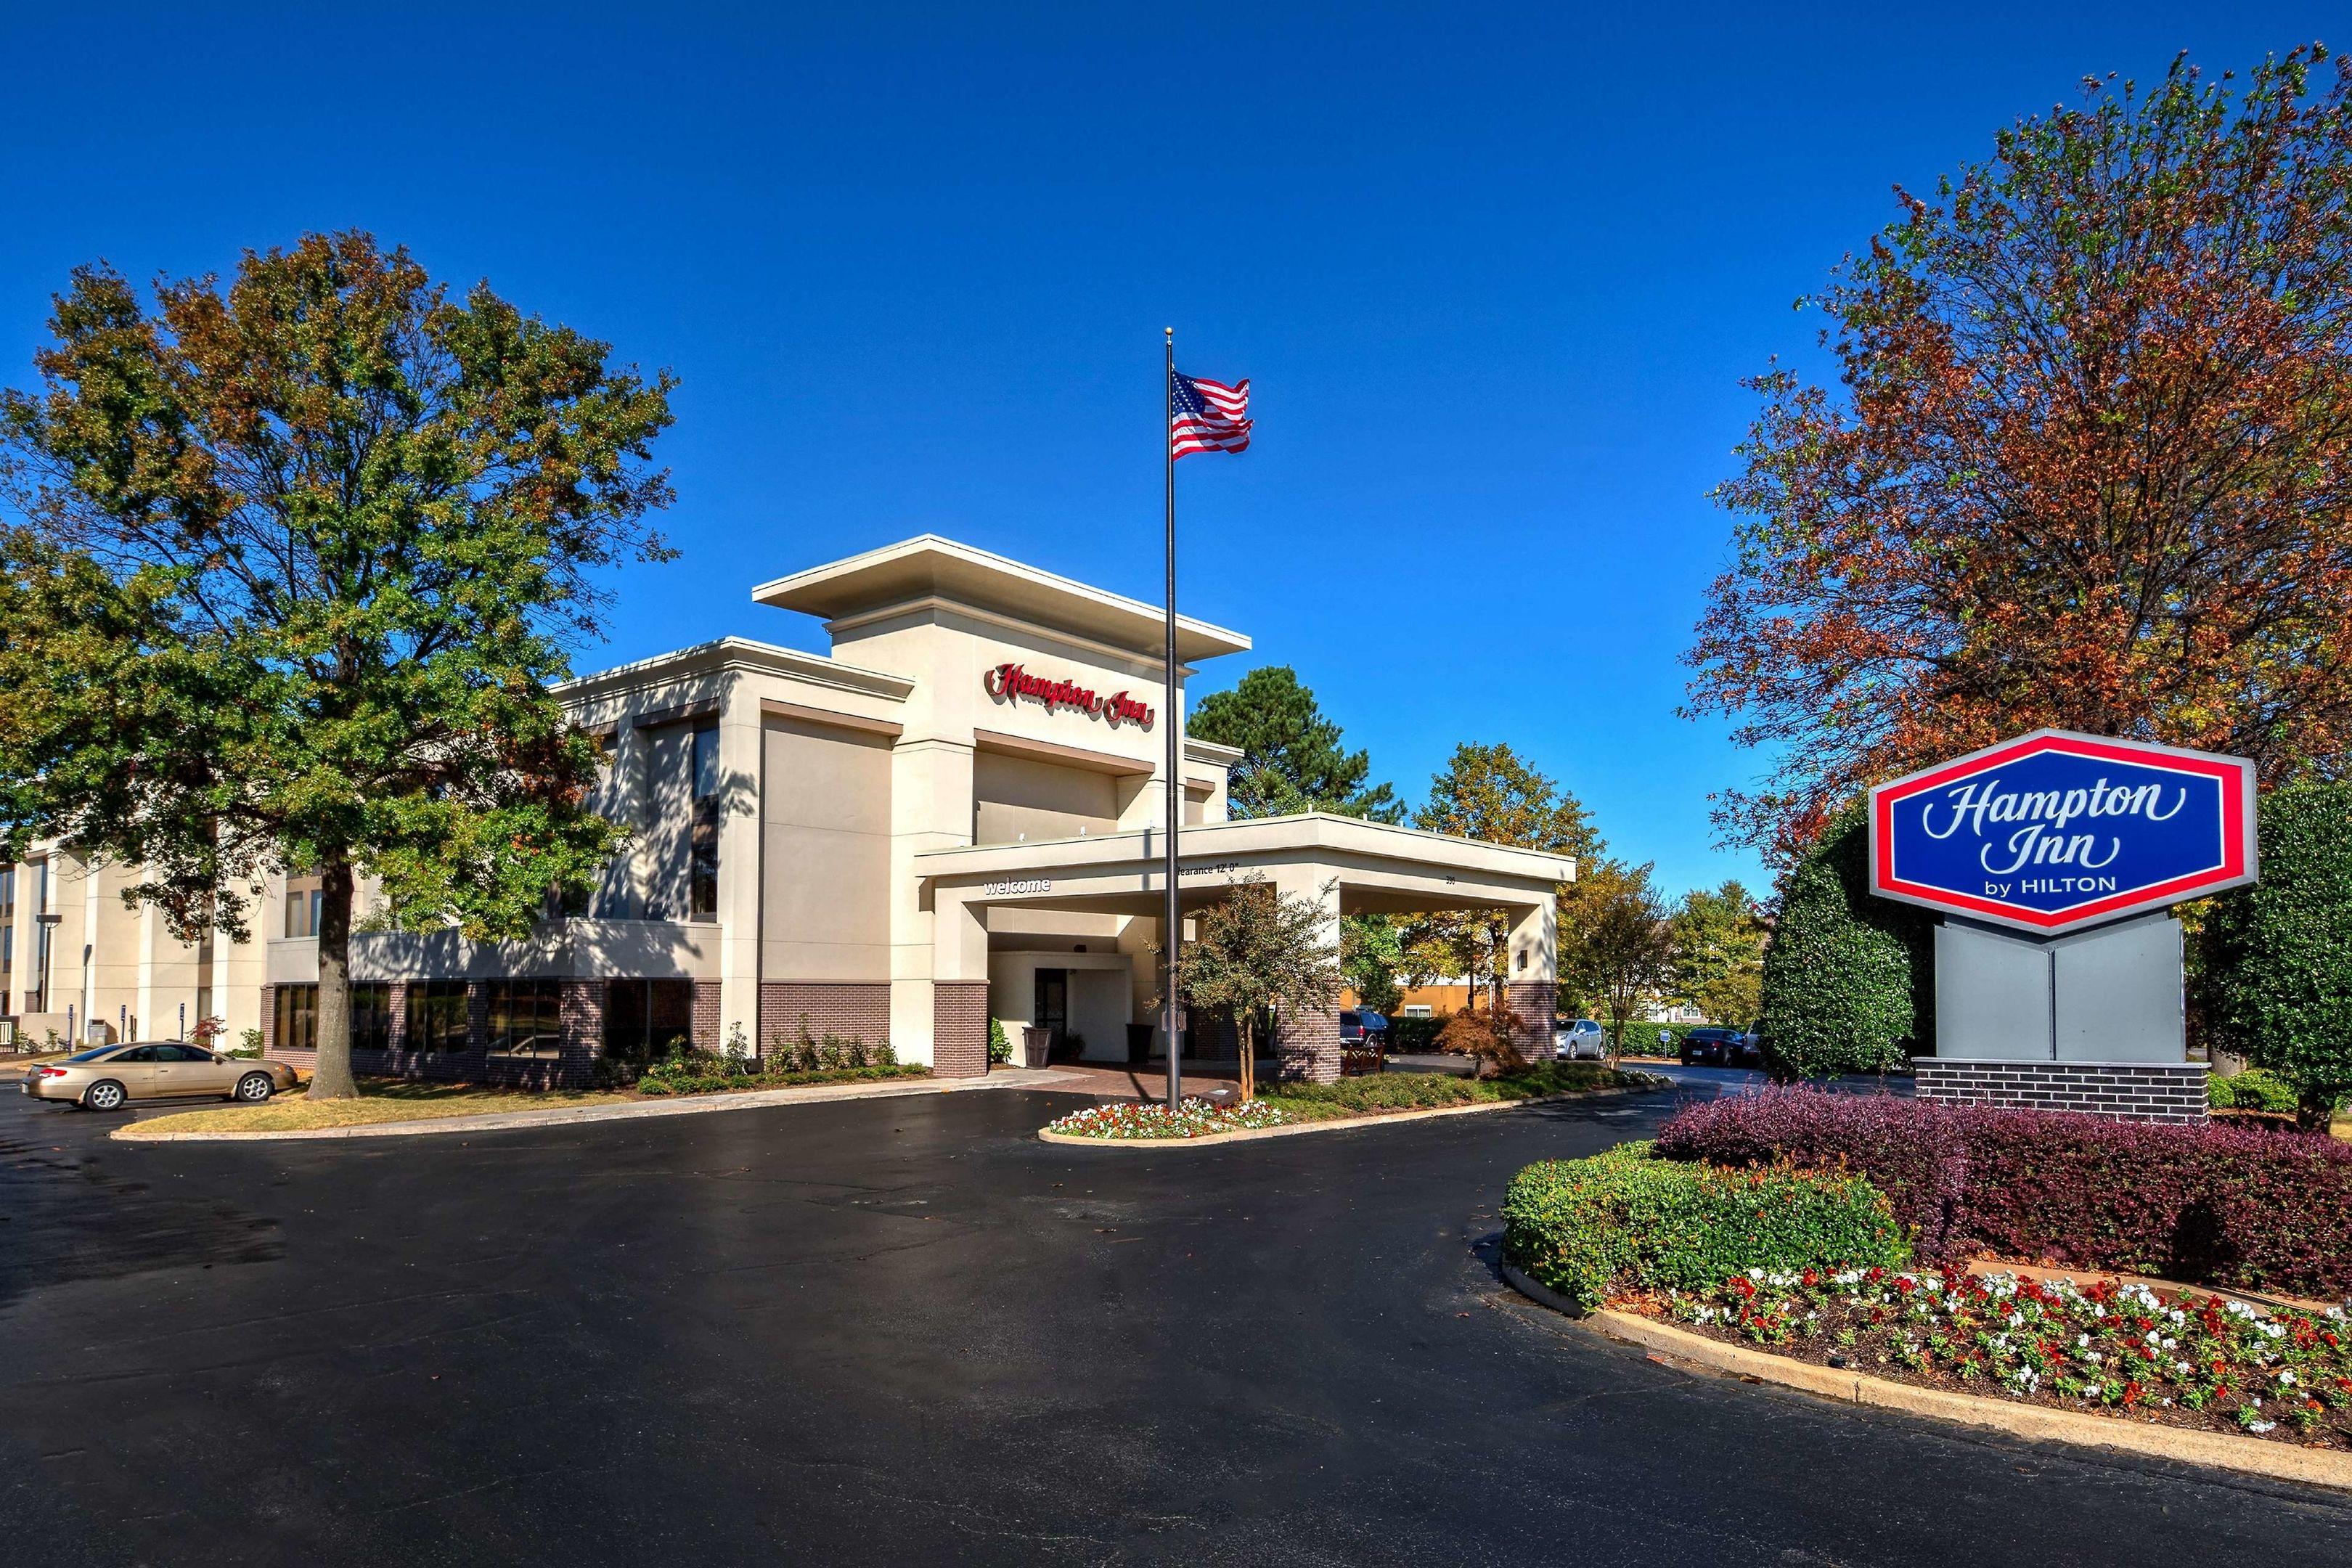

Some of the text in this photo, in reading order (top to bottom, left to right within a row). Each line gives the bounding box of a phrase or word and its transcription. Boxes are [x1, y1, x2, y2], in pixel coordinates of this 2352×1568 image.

[984, 663, 1154, 724] Hampton Inn
[1923, 778, 2186, 838] Hampton
[1980, 824, 2120, 874] Inn
[984, 876, 1051, 895] welcome
[1177, 865, 1213, 875] learance
[1985, 877, 2116, 897] by HILTON
